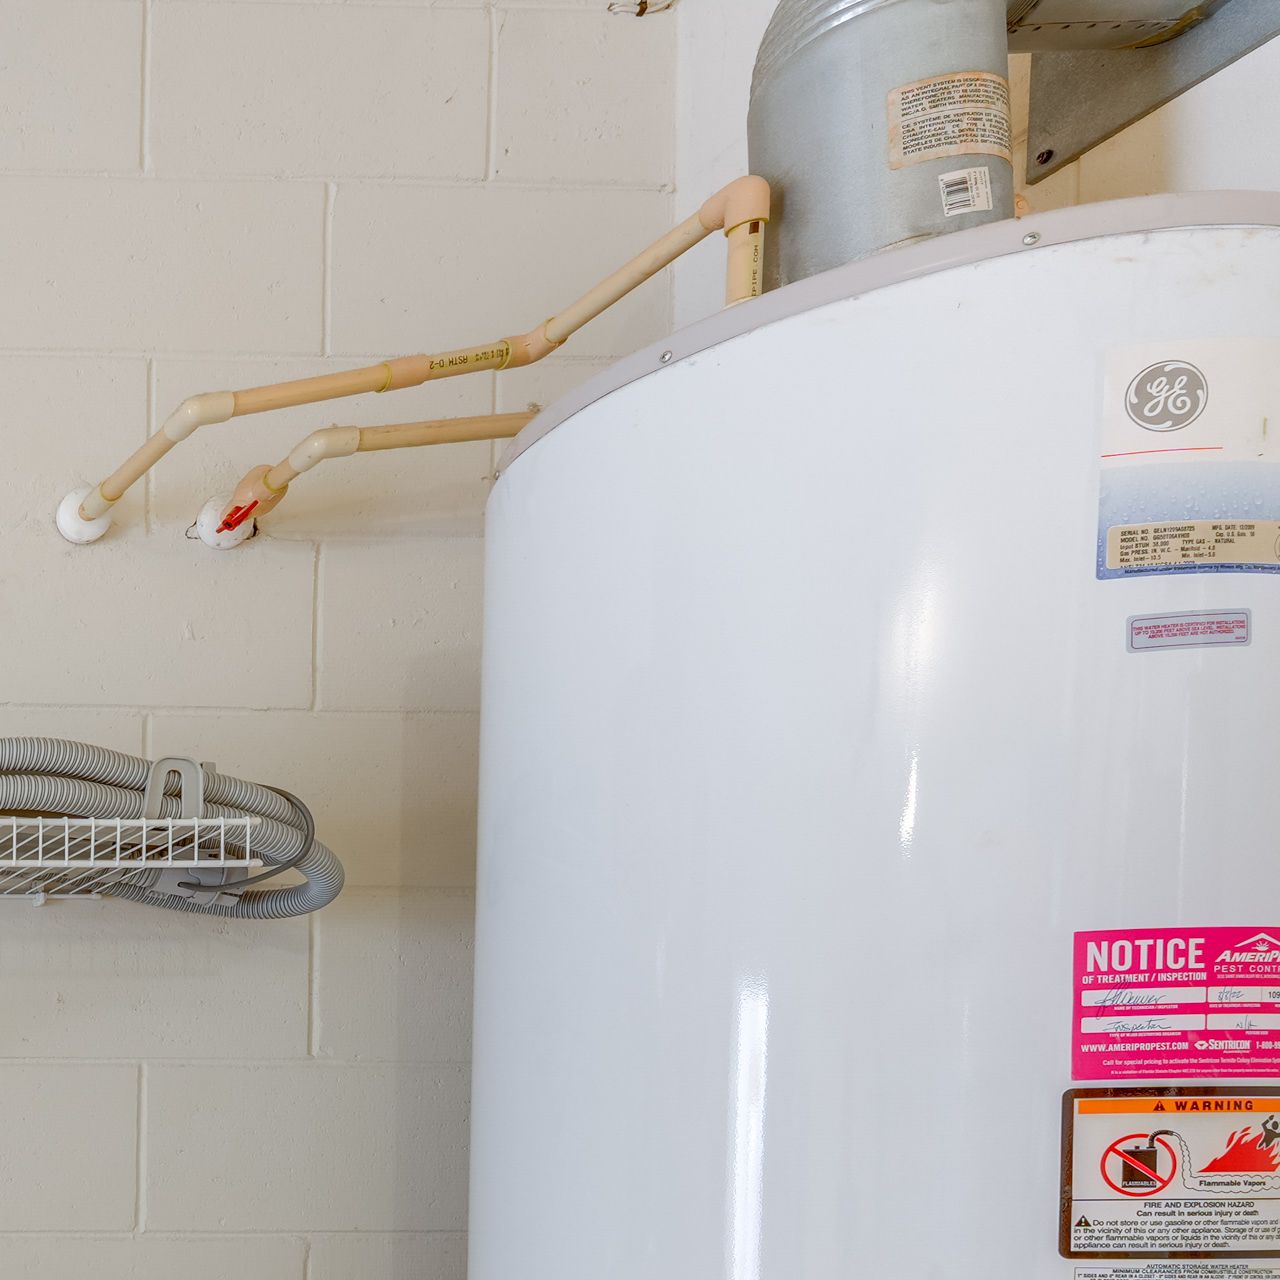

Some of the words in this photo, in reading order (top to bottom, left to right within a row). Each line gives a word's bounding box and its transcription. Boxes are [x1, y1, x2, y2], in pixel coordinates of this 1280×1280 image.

[1143, 376, 1191, 416] GE
[1087, 938, 1205, 972] NOTICE
[1082, 976, 1095, 984] OF
[1097, 973, 1149, 983] TREATMENT
[1158, 972, 1206, 981] INSPECTION
[1081, 1042, 1189, 1052] WWW.AMERIPROPEST.COM
[1209, 1040, 1251, 1050] SENTRICON
[1175, 1101, 1253, 1110] WARNING
